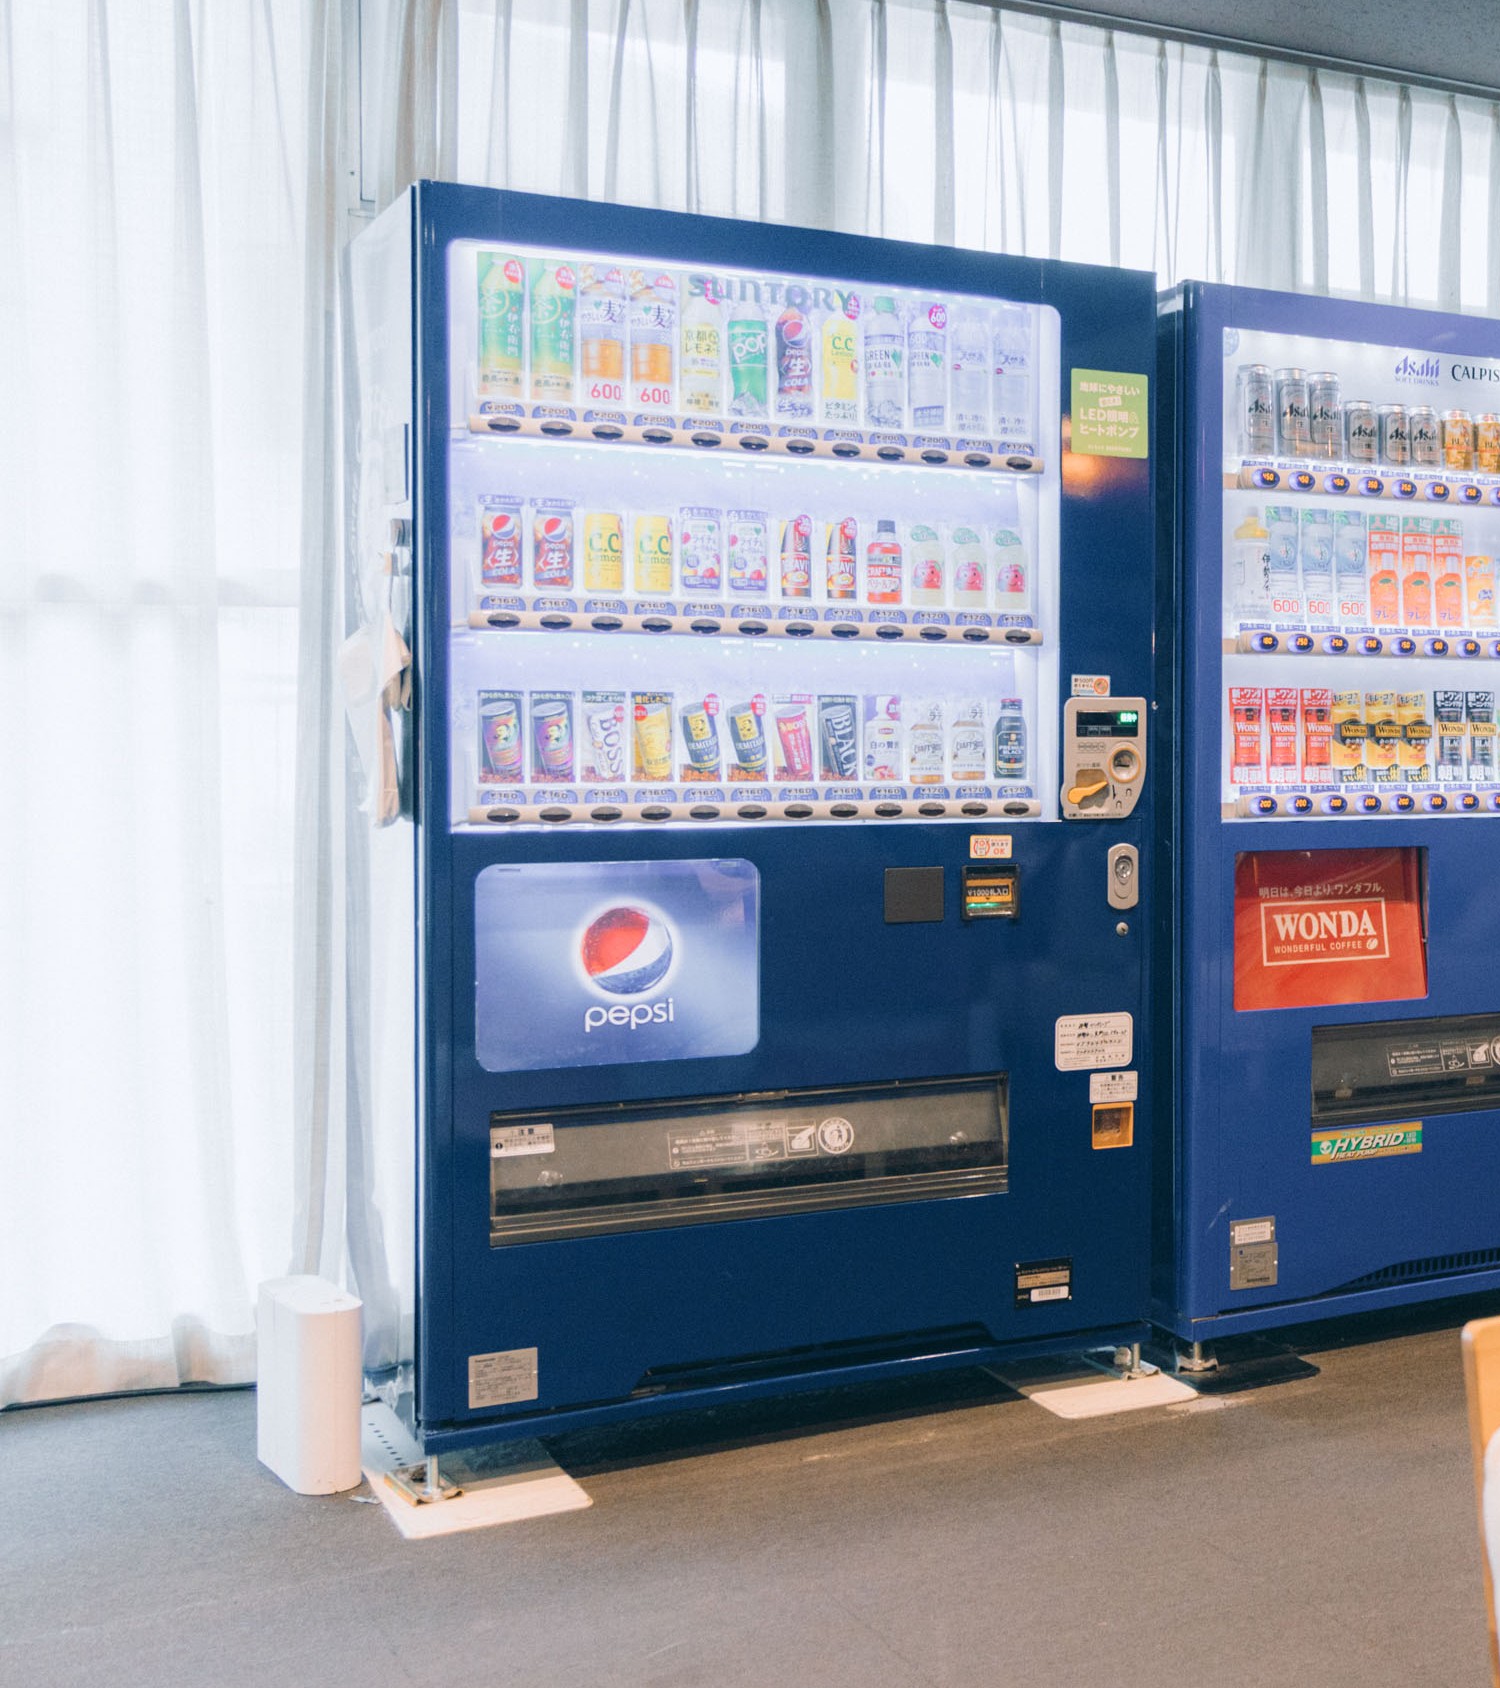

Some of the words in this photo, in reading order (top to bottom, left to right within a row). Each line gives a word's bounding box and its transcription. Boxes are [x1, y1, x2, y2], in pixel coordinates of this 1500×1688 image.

[1395, 355, 1440, 378] Asahi
[1451, 364, 1500, 382] CALPIS
[590, 384, 622, 400] 600
[640, 388, 670, 404] 600
[1080, 423, 1140, 439] ヒートポンプ
[1273, 600, 1299, 613] 600
[831, 712, 857, 777] BLACK
[1259, 882, 1385, 898] 明日は、今日より、ワンダフル。
[1273, 909, 1376, 941] WONDA
[1274, 942, 1326, 954] WONDERFUL
[1330, 940, 1362, 951] COFFEE
[585, 998, 674, 1032] pepsi
[1335, 1132, 1404, 1151] HYBRID
